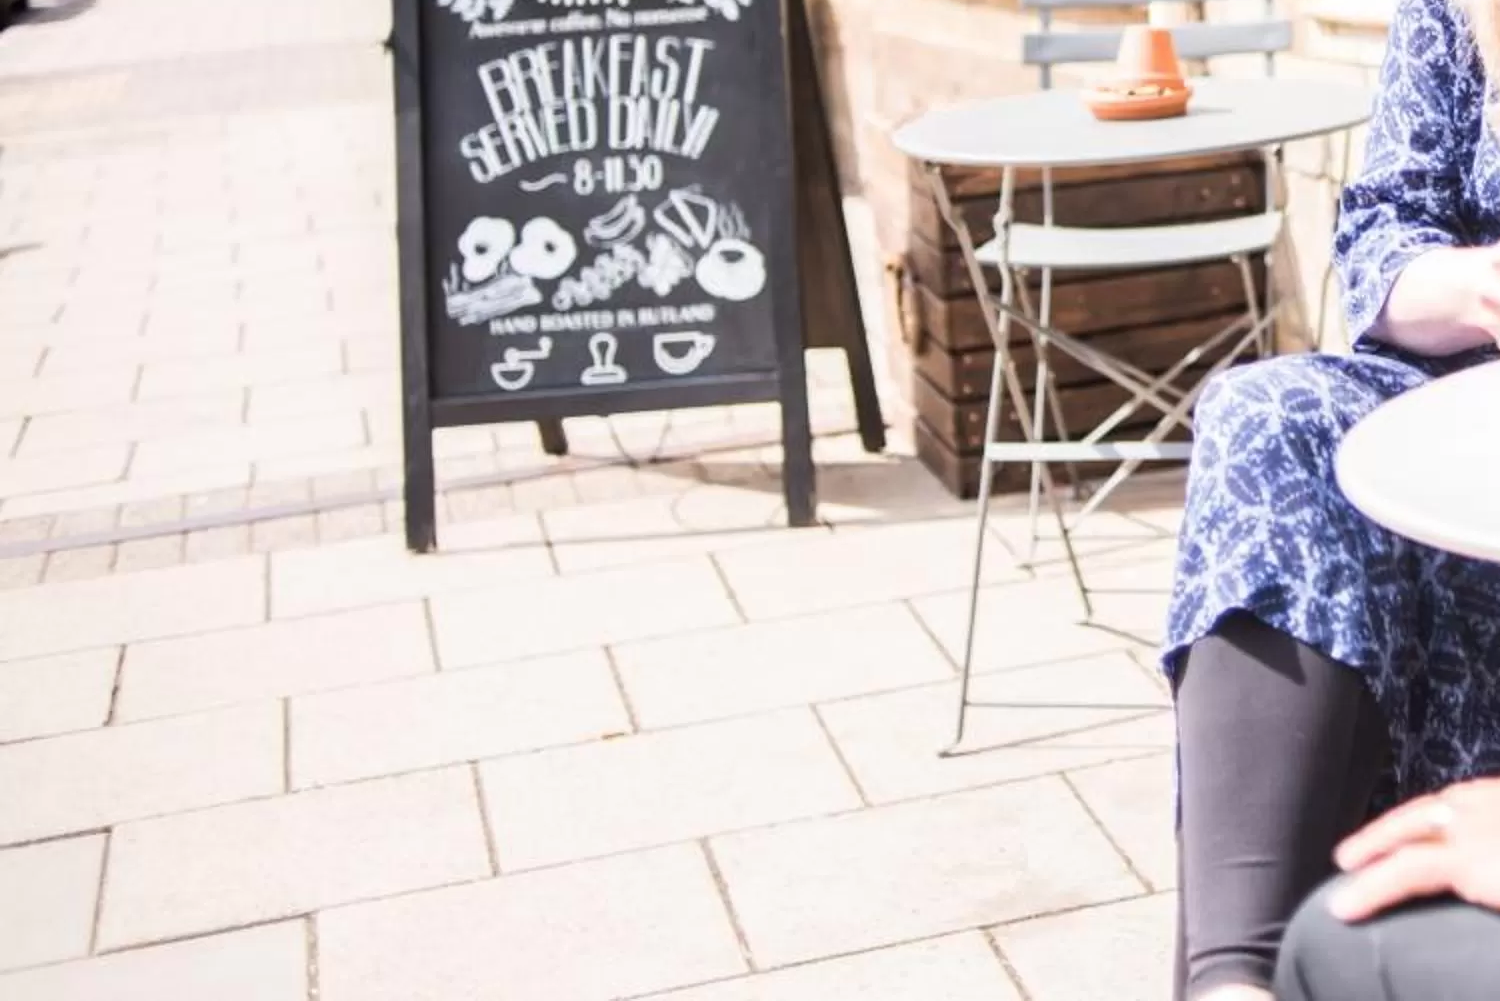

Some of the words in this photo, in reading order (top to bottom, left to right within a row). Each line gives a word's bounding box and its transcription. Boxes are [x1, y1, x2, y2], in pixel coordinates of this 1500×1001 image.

[477, 33, 716, 120] BREAKFAST
[460, 95, 598, 184] SERVED
[489, 315, 538, 336] HAND
[540, 310, 615, 332] ROASTED
[616, 308, 636, 328] IN
[637, 303, 716, 327] RUTLAND
